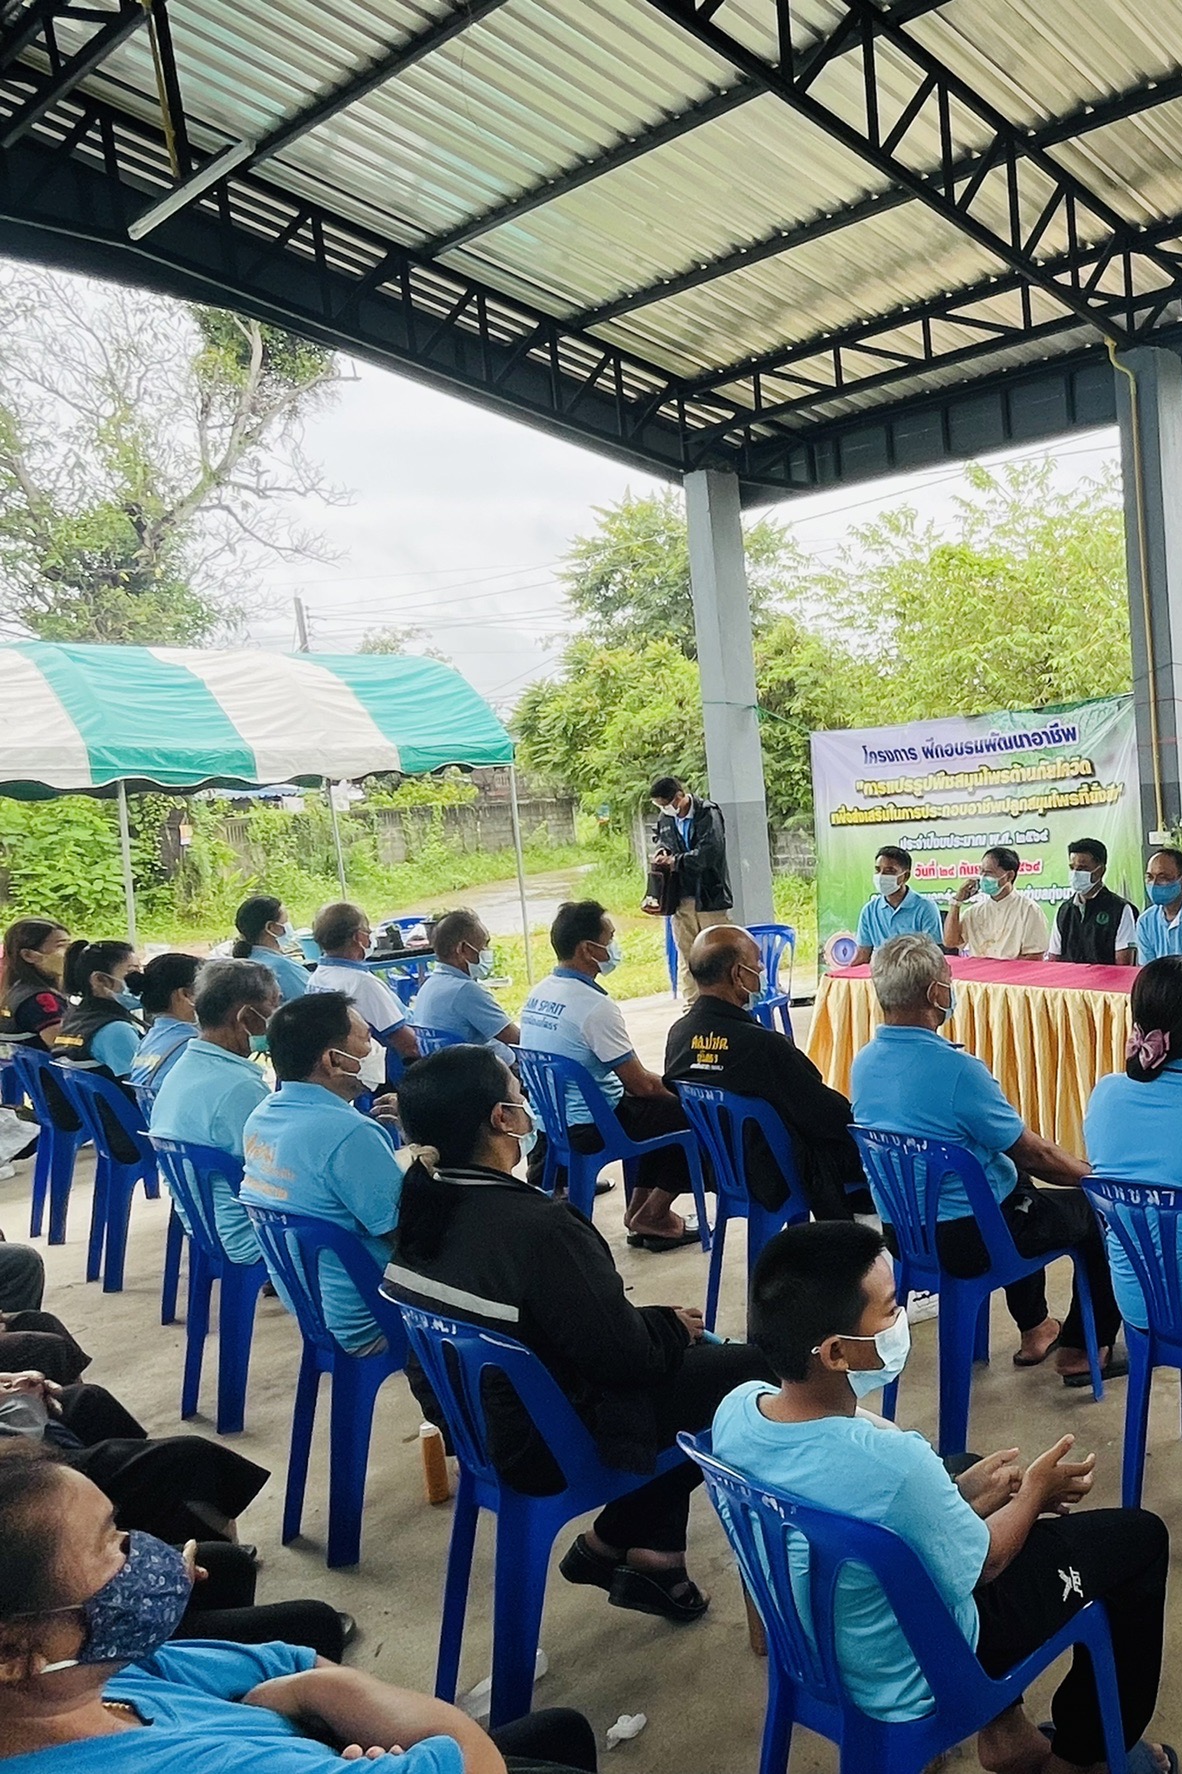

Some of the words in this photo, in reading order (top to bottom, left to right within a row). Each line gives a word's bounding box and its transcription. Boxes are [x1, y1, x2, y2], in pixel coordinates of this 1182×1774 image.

[862, 745, 918, 765] โครงการ
[914, 859, 936, 878] วันที่
[1018, 860, 1041, 875] ๕๖๔
[538, 1000, 566, 1016] SPIRIT
